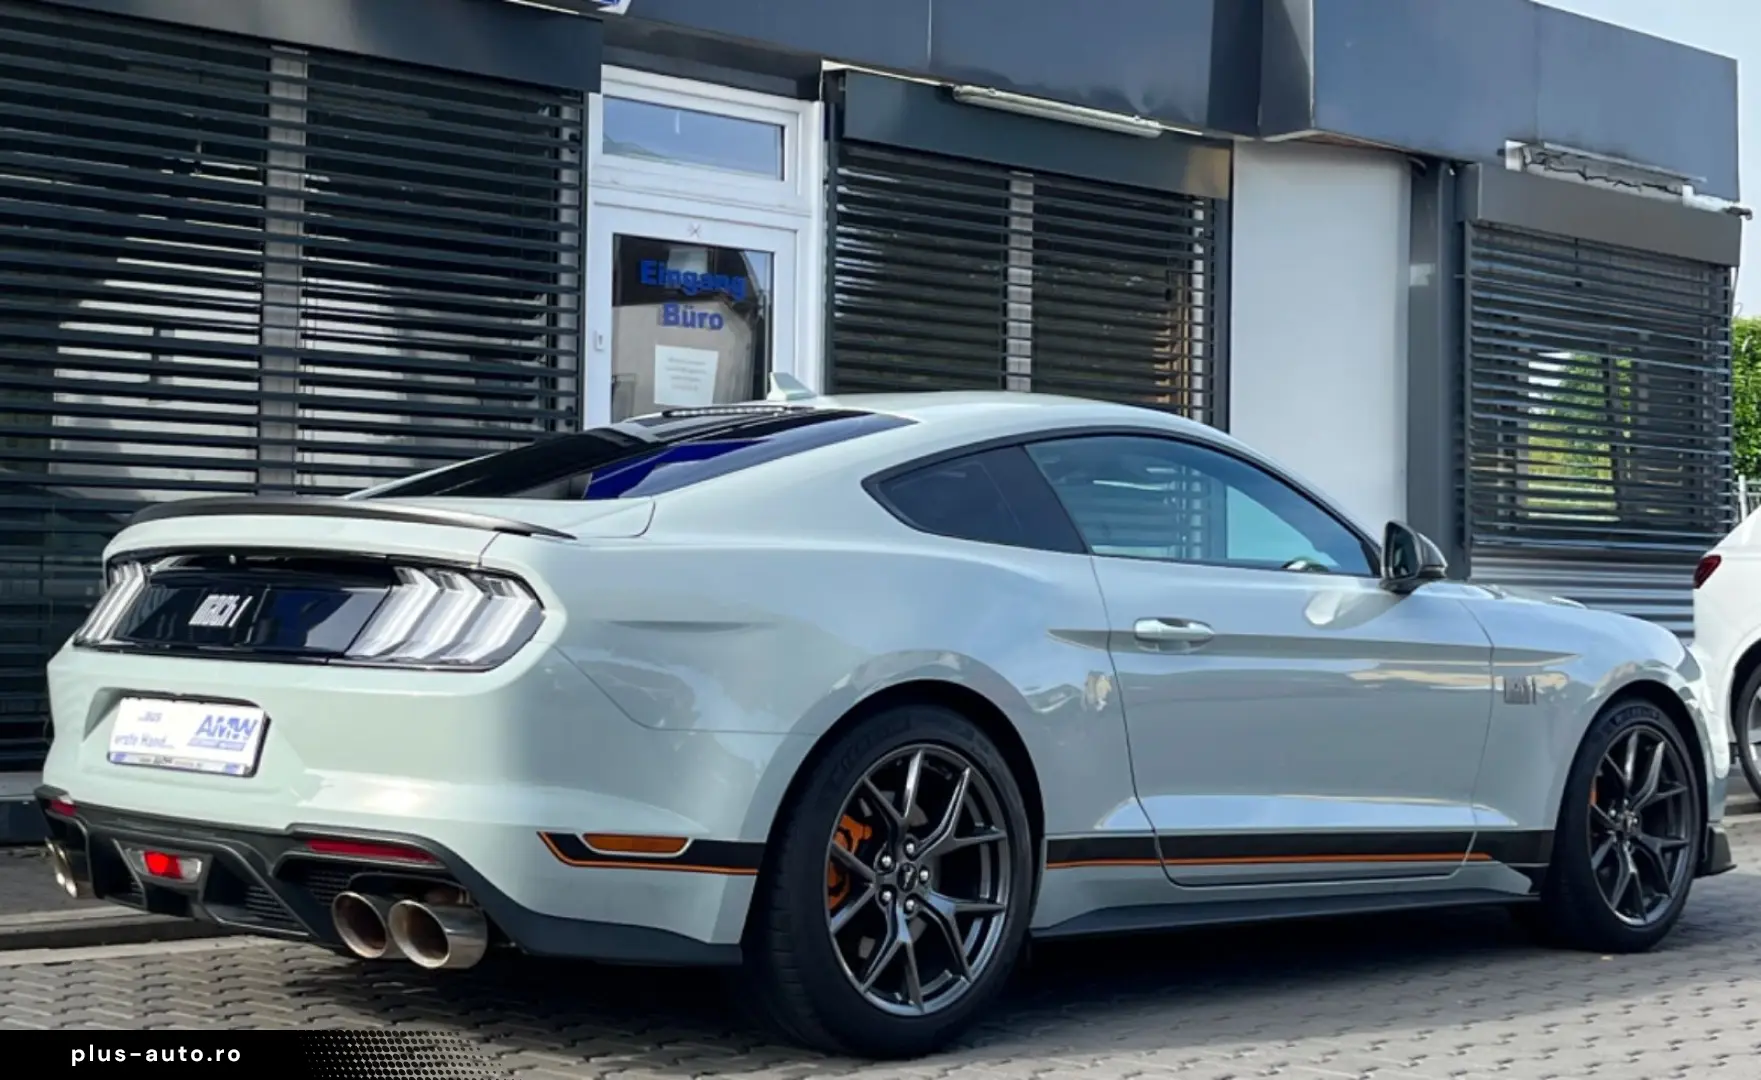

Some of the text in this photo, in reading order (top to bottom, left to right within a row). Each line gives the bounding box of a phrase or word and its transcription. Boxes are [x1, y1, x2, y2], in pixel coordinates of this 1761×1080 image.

[640, 259, 746, 300] Eingang
[662, 303, 724, 331] Büro
[194, 714, 259, 741] AMW
